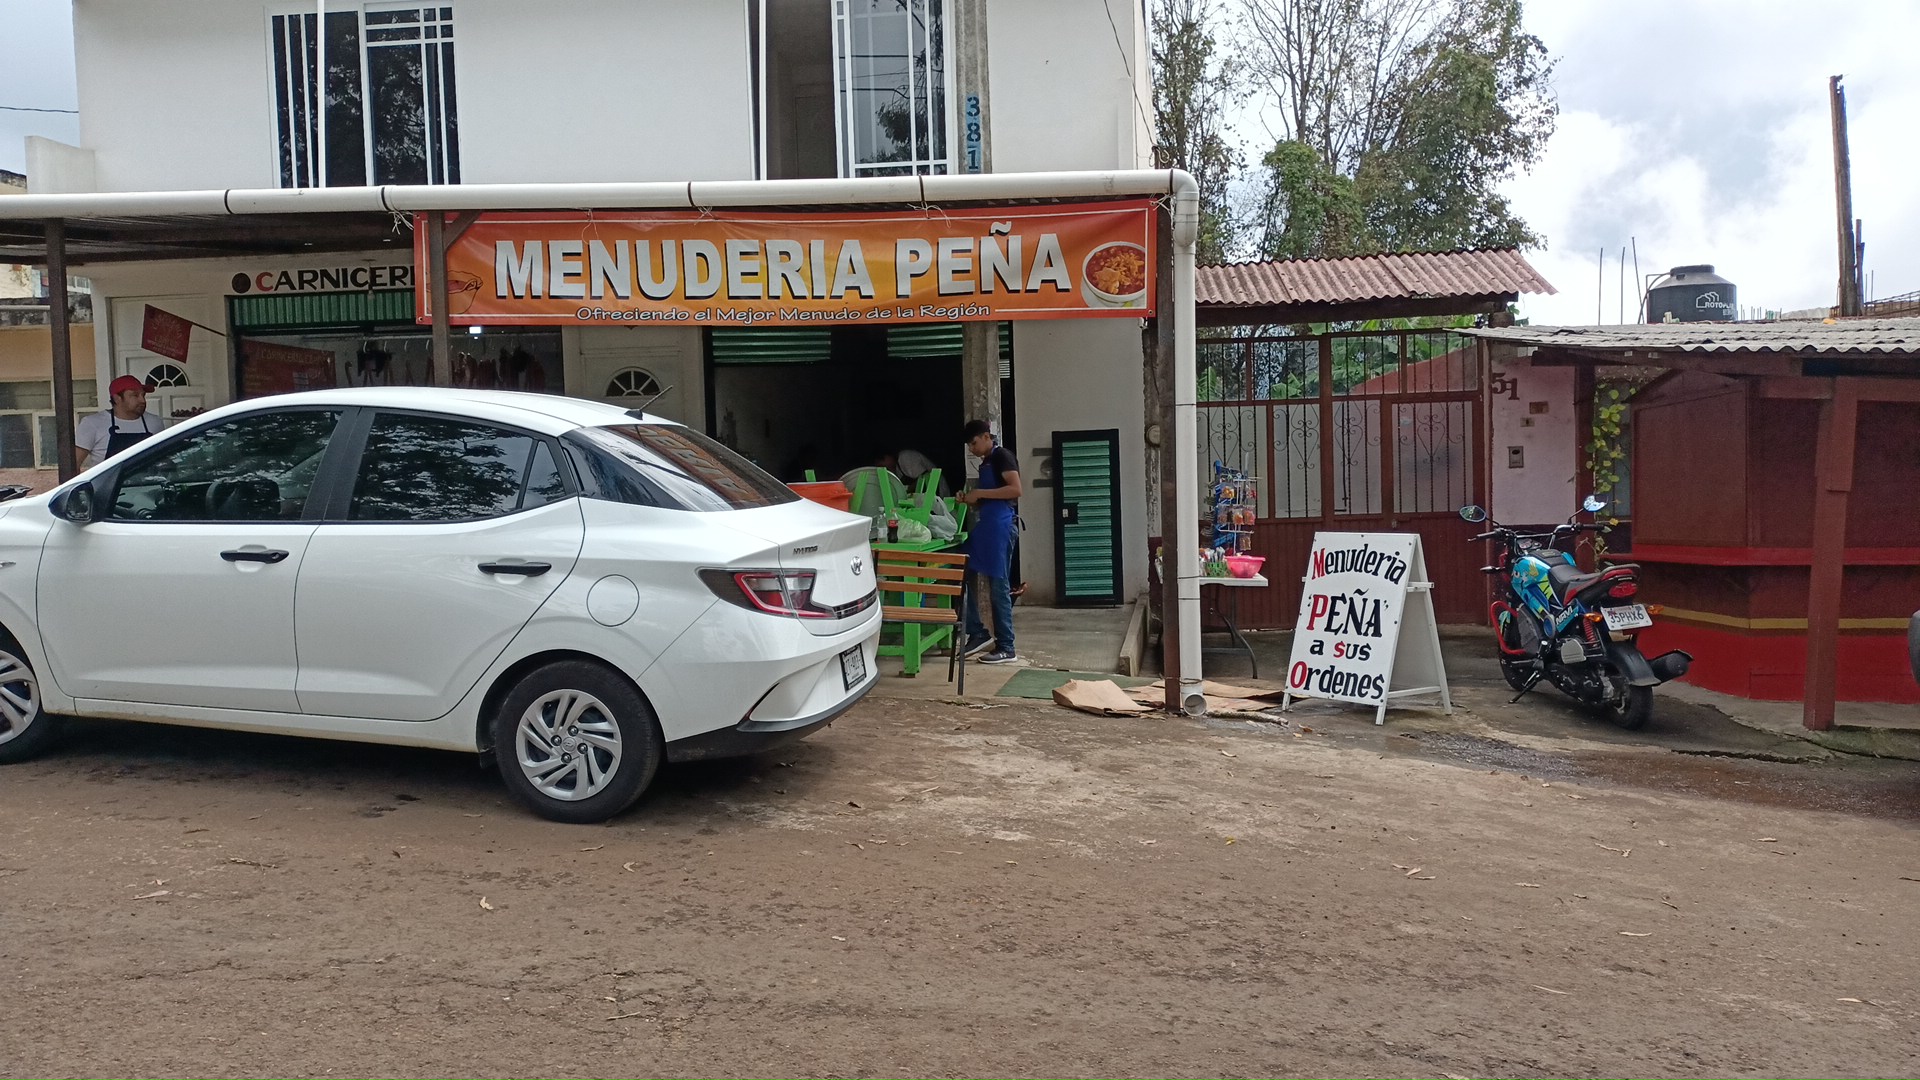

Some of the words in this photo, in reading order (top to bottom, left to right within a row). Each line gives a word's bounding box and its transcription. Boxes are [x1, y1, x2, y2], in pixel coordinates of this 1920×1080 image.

[494, 238, 875, 300] MENUDERIA
[895, 220, 1073, 299] PEÑA
[575, 306, 690, 321] Ofreciendo
[694, 307, 712, 321] el
[715, 307, 775, 325] Mejor
[779, 307, 861, 321] Menudo
[866, 305, 892, 320] de
[896, 304, 915, 319] la
[919, 302, 990, 320] Región
[1311, 543, 1407, 585] Menuderia
[1309, 639, 1324, 656] a
[1333, 640, 1372, 661] sus
[1290, 660, 1385, 700] Ordenes
